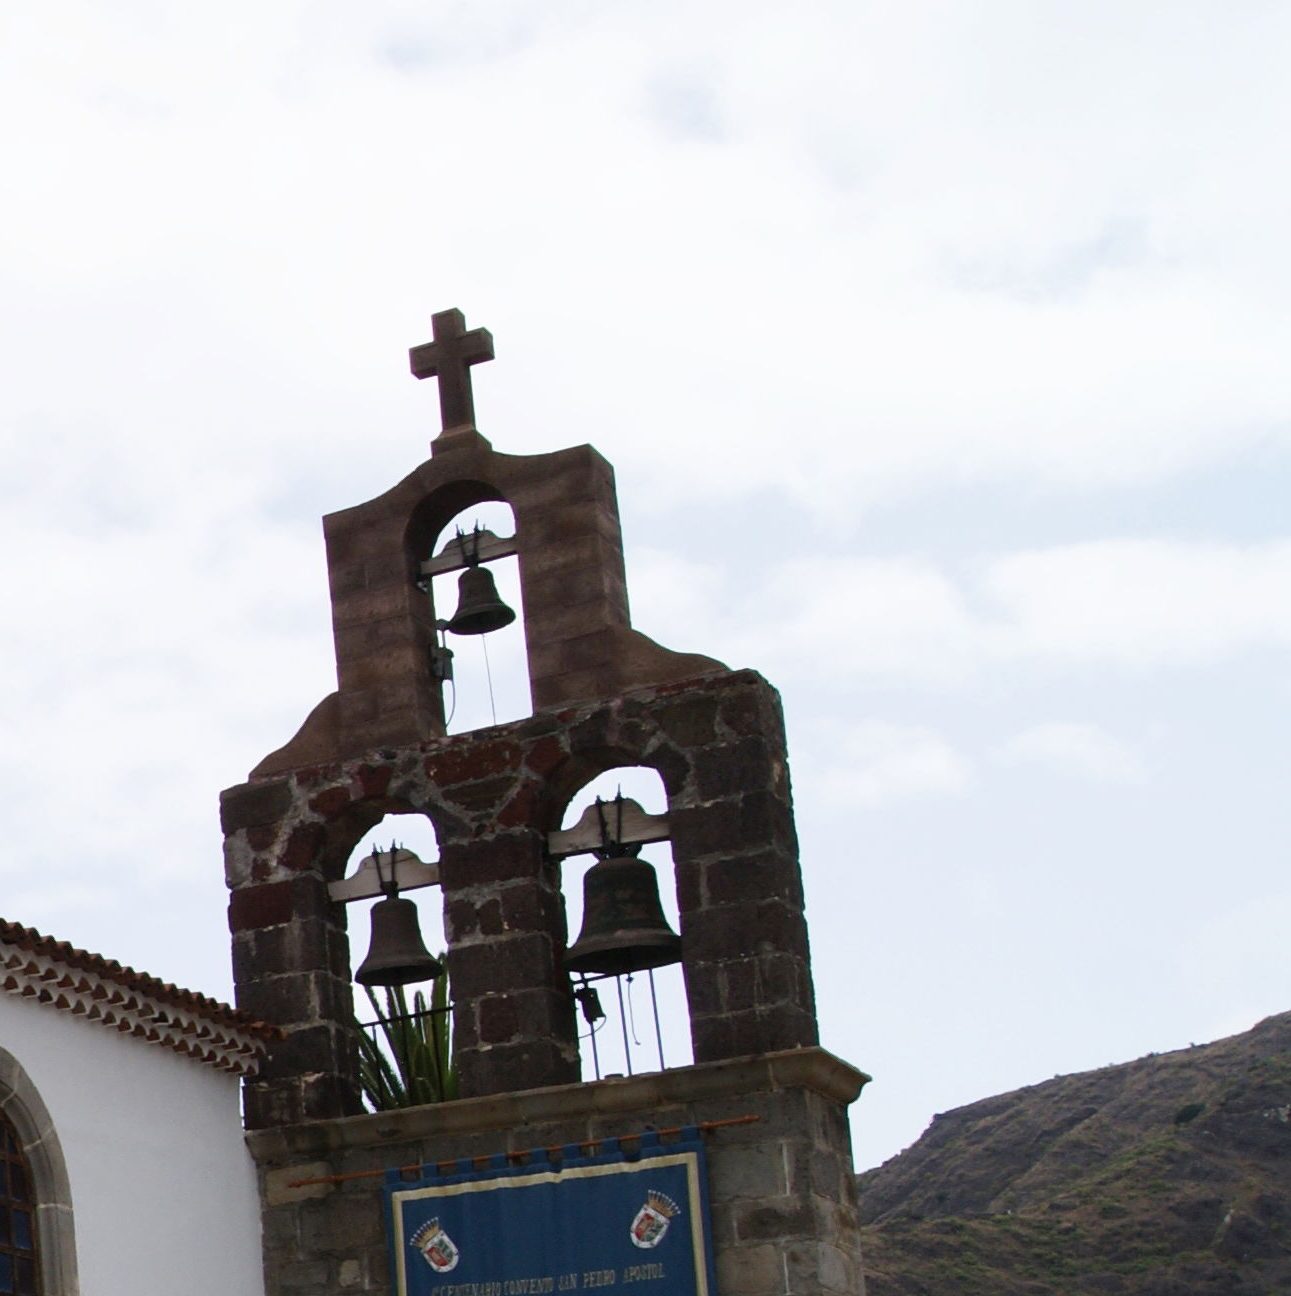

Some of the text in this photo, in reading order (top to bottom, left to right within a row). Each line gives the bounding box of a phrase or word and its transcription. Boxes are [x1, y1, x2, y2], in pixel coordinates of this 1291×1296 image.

[504, 1276, 554, 1296] CONVENTO
[558, 1273, 577, 1291] SAN
[583, 1269, 616, 1288] PEDRO
[622, 1262, 666, 1284] APOSTOL
